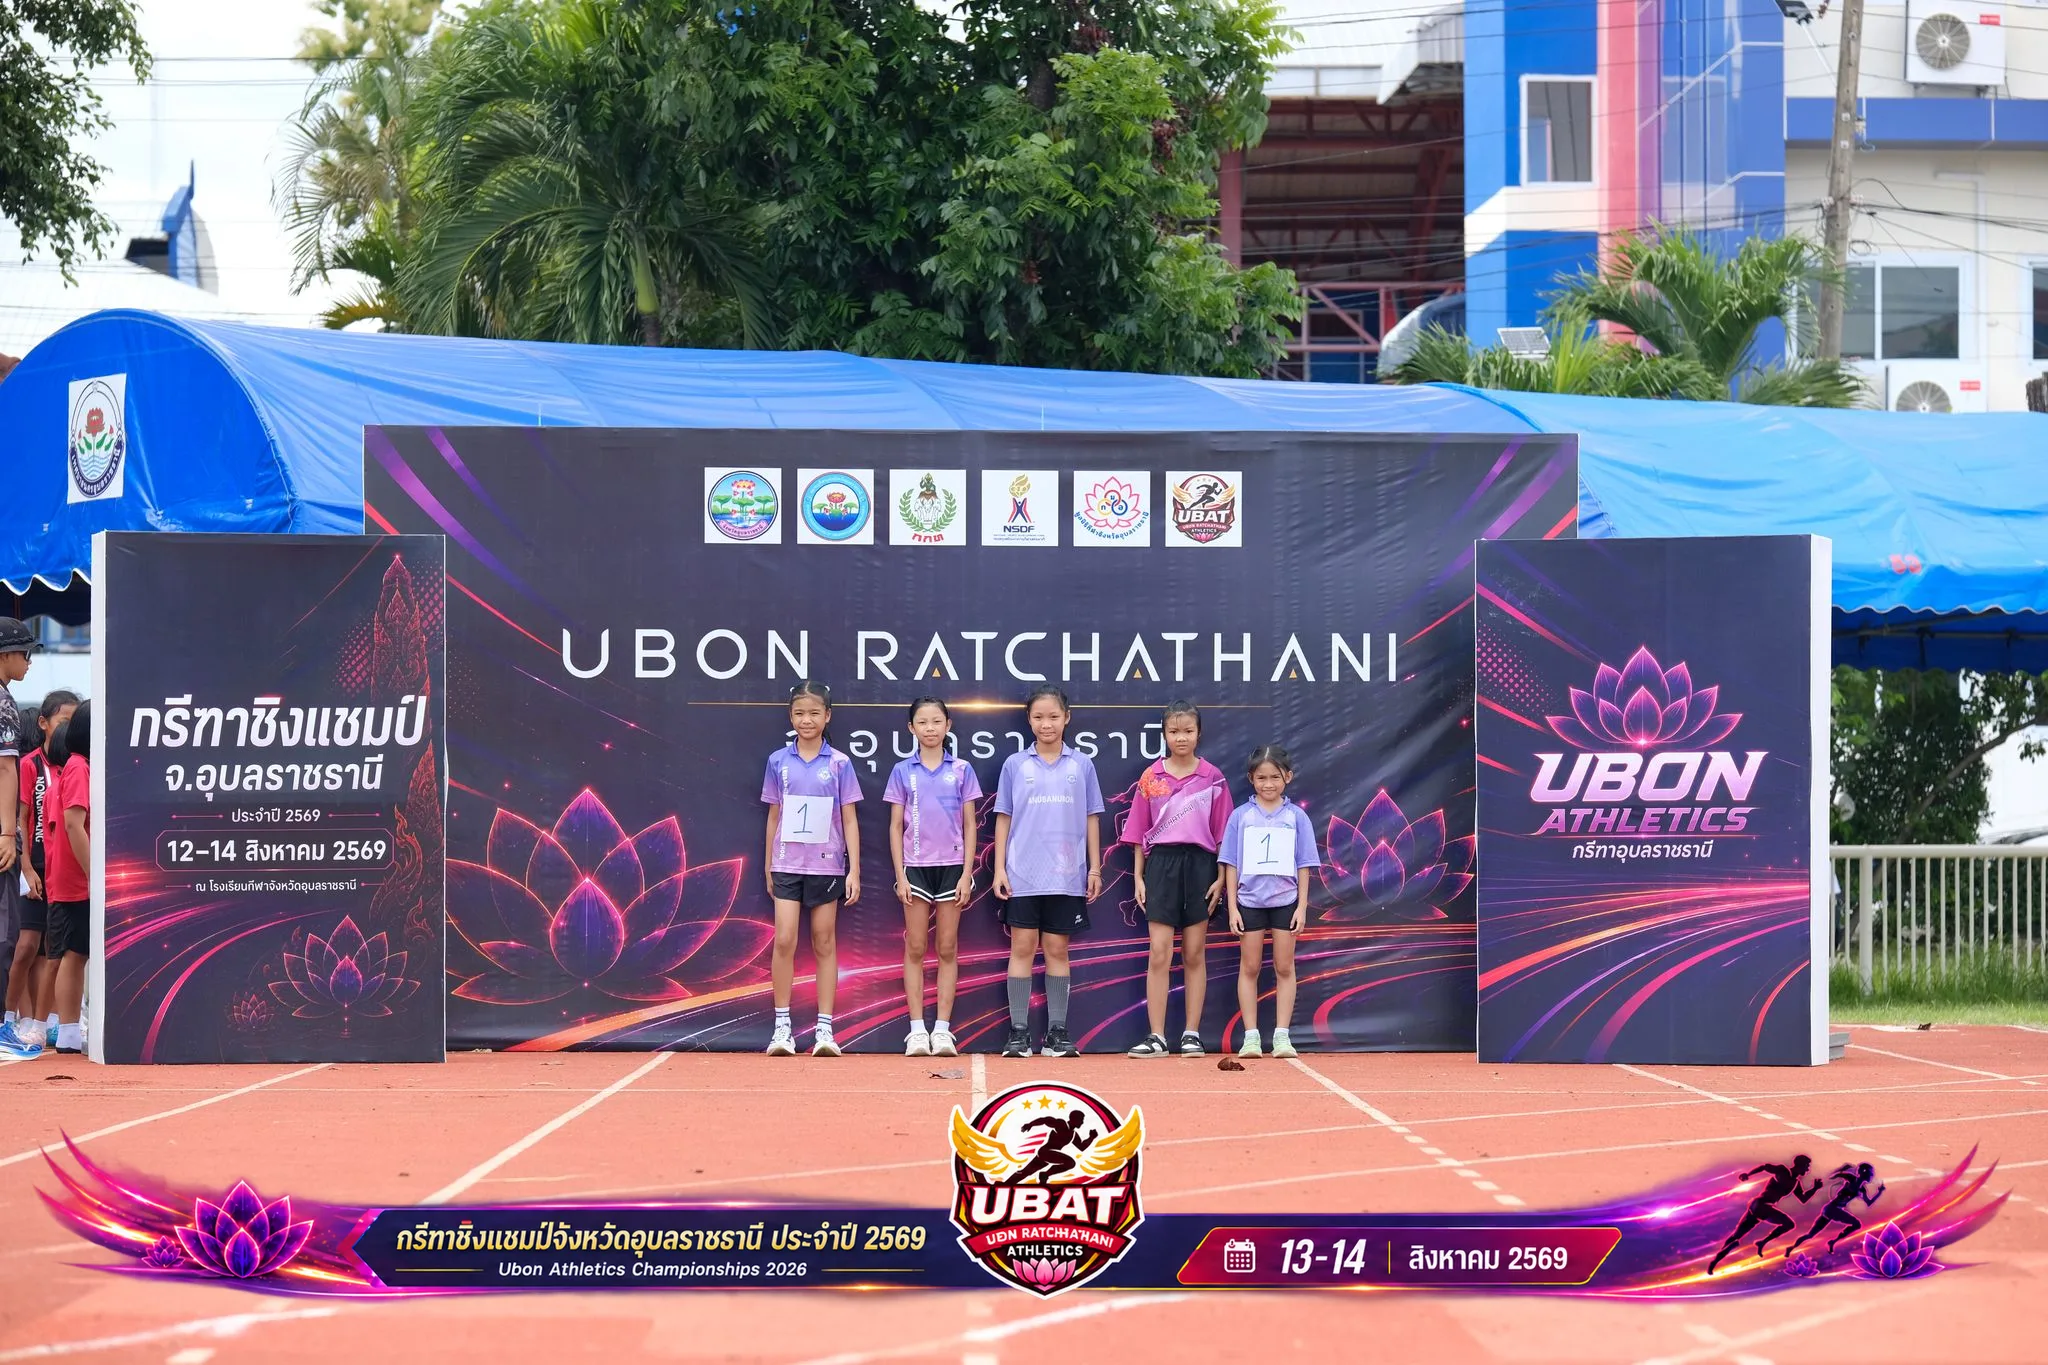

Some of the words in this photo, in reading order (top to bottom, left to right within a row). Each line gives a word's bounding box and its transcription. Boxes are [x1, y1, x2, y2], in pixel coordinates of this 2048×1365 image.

[1003, 525, 1036, 533] NSDF
[1177, 509, 1231, 523] UBAT
[562, 628, 808, 680] UBON
[857, 630, 1397, 682] RATCHATHANI
[129, 694, 428, 748] กรีฑาชิงแชมป์
[165, 753, 384, 802] จ.อุบลราชธานี
[1530, 751, 1769, 803] UBON
[231, 807, 281, 823] ประจำปี
[285, 808, 321, 823] 2569
[793, 803, 813, 834] 1
[1533, 807, 1761, 836] ATHLETICS
[245, 839, 325, 862] สิงหาคม
[332, 840, 387, 861] 2569
[1257, 833, 1279, 865] 1
[1572, 840, 1714, 864] กรีฑาอุบลราชธานี
[209, 878, 357, 895] โรงเรียนกีฬาจังหวัดอุบลราชธานี
